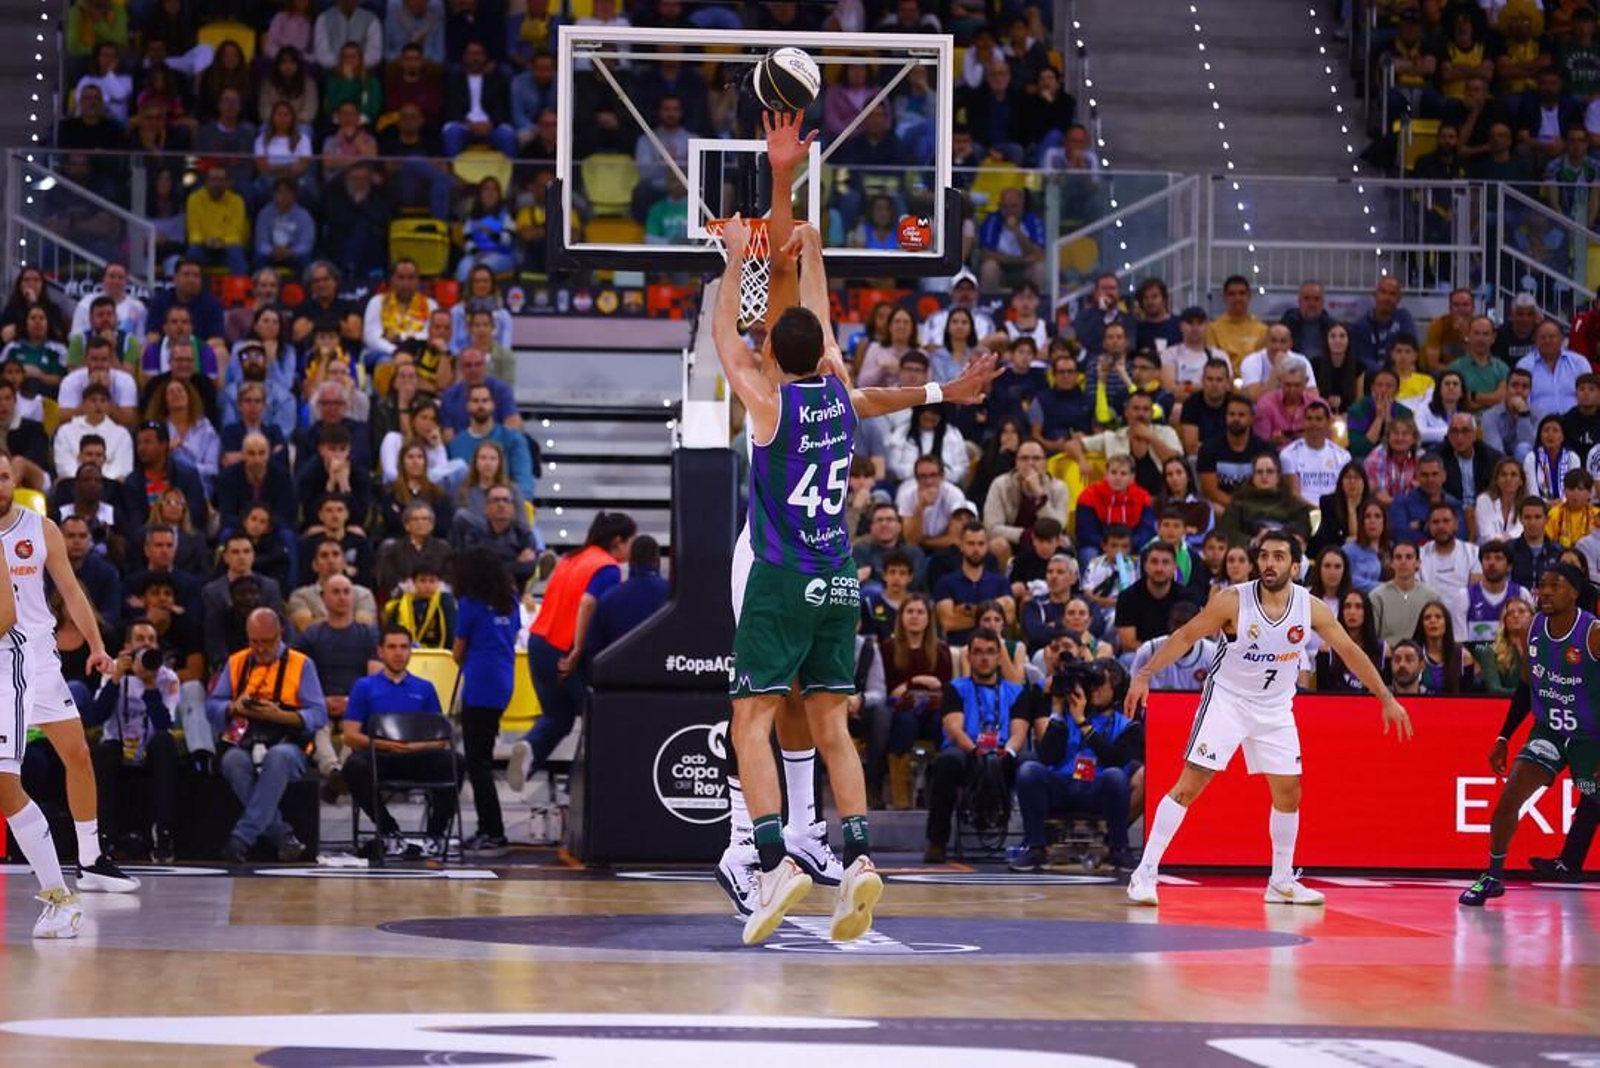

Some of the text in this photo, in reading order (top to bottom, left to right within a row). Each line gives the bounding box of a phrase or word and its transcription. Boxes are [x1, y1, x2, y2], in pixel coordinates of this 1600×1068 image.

[799, 397, 846, 424] Kravish
[787, 456, 849, 518] 45
[1262, 669, 1278, 690] 7
[1549, 708, 1578, 731] 55
[681, 754, 707, 765] acb
[672, 763, 719, 781] Copa
[694, 780, 725, 798] Rey
